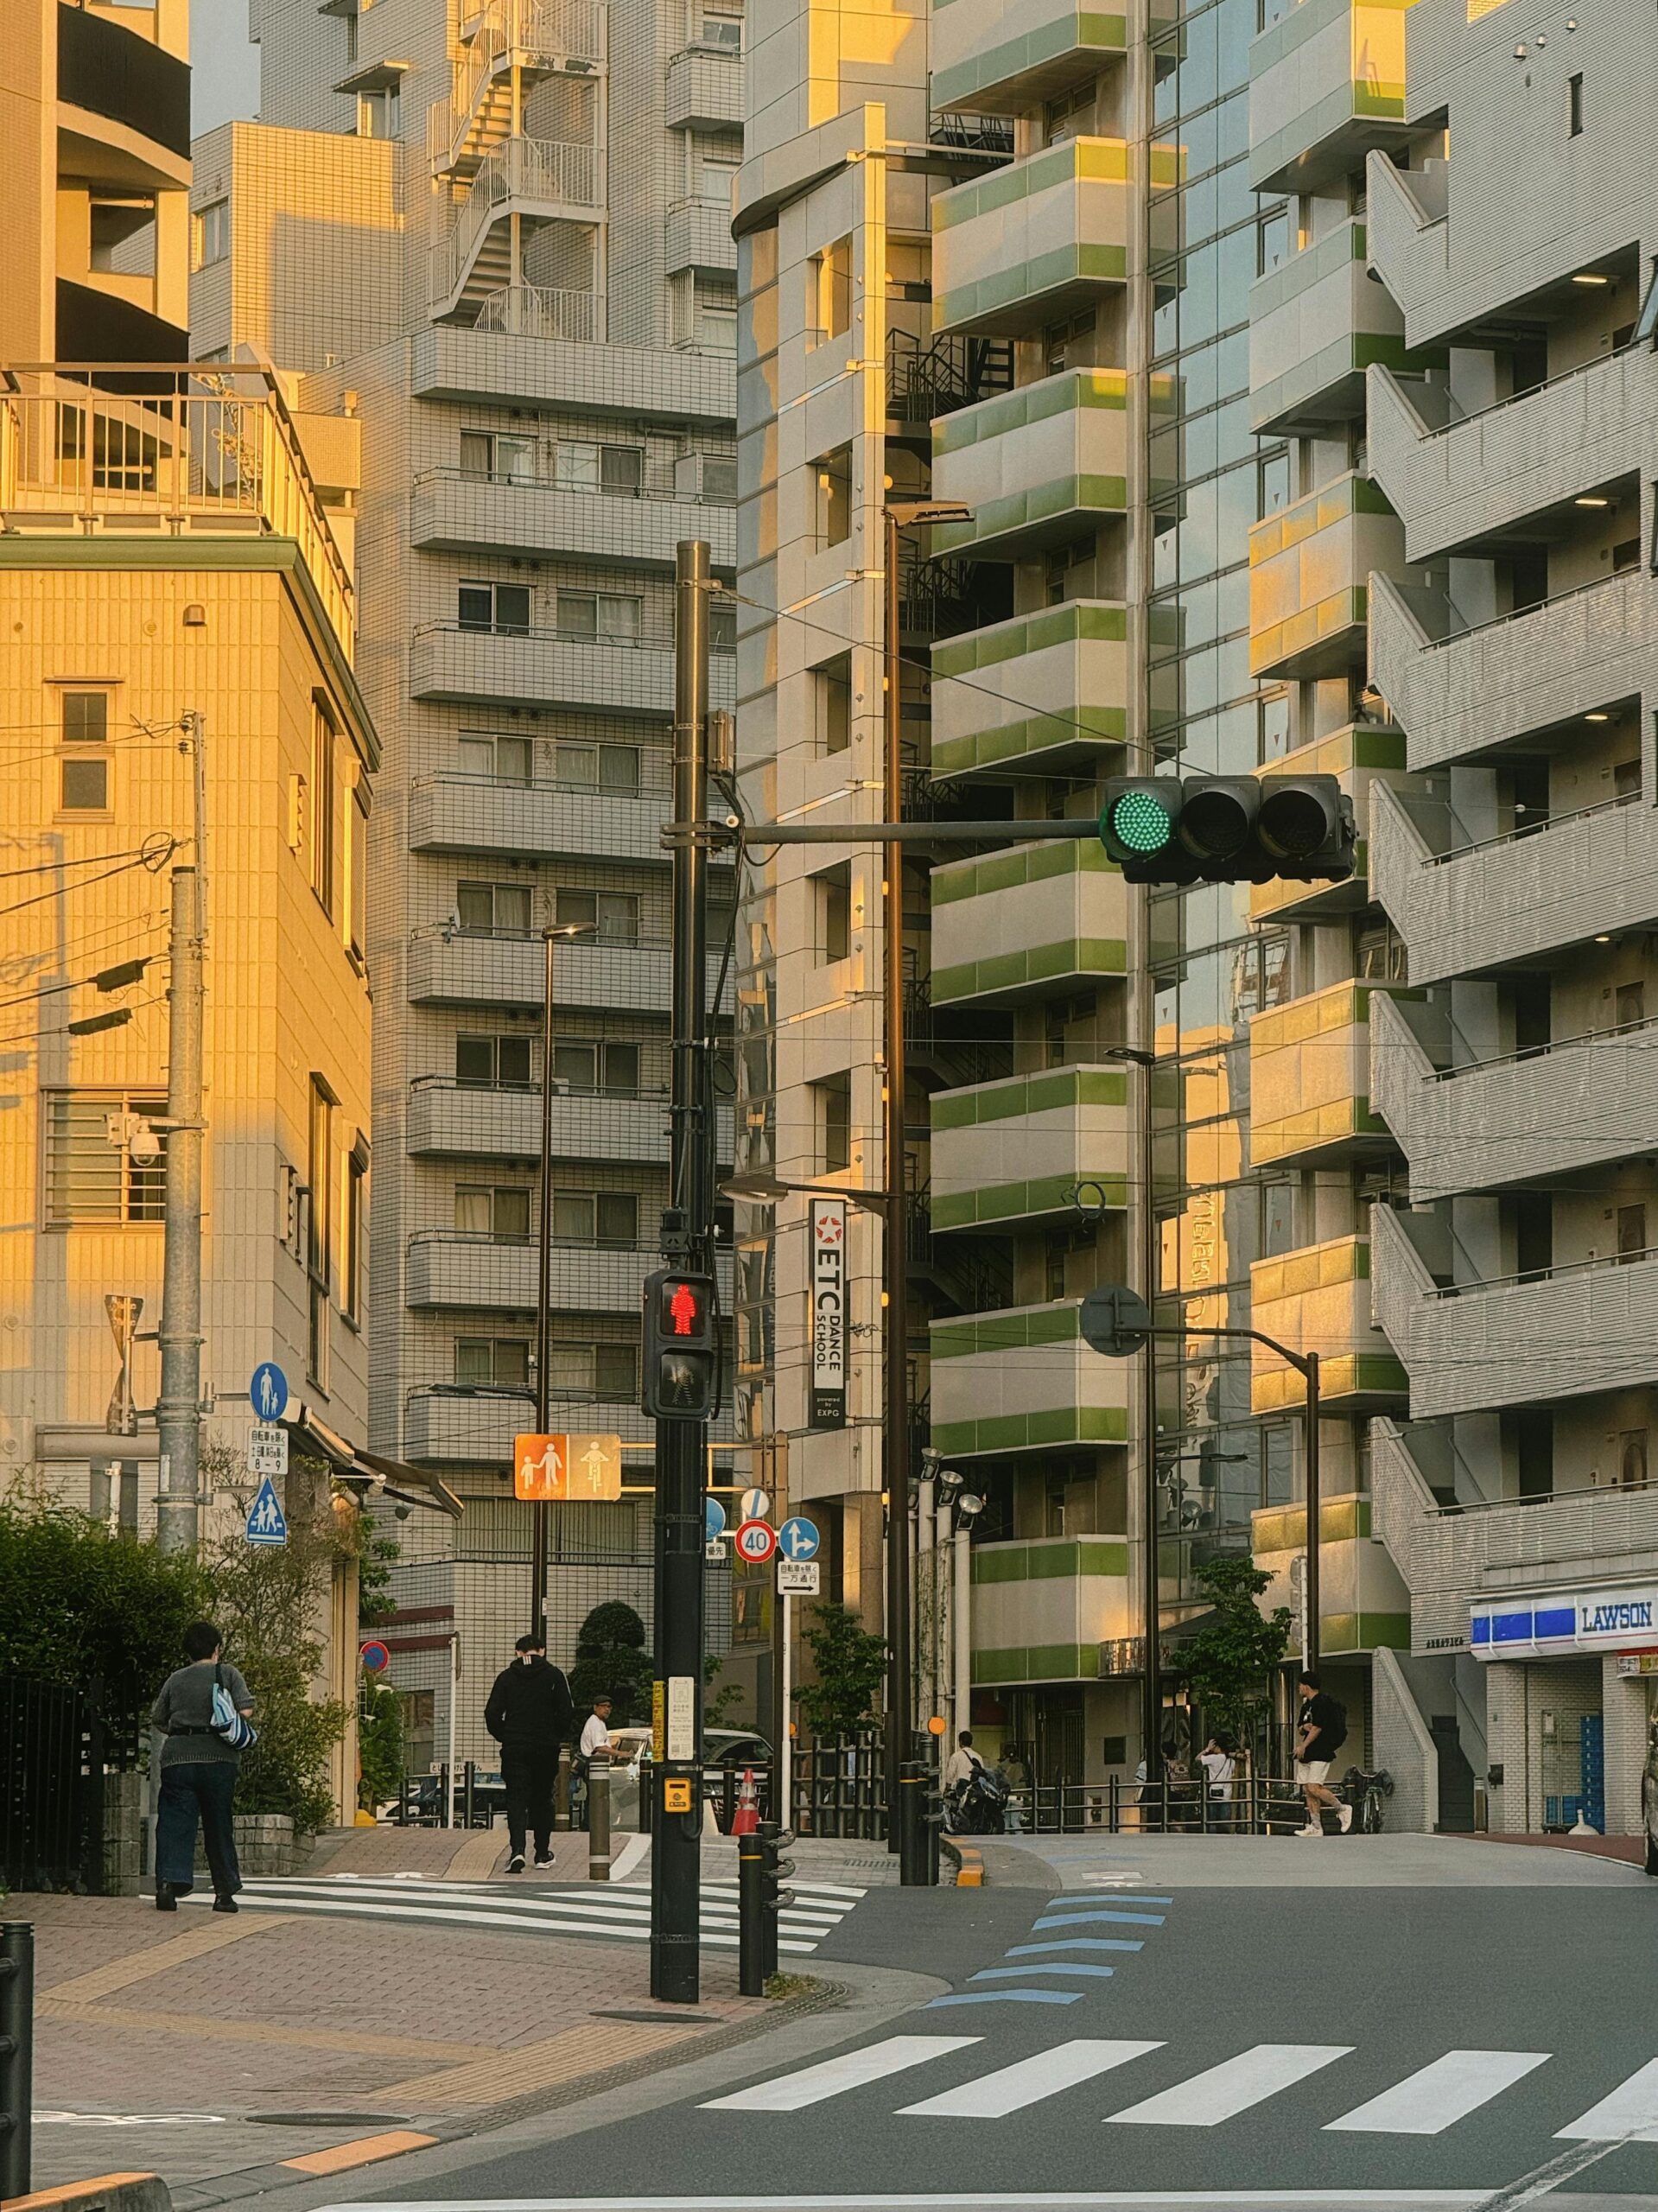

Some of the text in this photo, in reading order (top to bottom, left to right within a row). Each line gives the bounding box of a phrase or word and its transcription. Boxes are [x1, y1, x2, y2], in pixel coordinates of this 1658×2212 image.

[817, 1249, 840, 1311] ETC
[816, 1315, 826, 1370] SCHOOL
[829, 1315, 841, 1371] DANCE
[745, 1532, 767, 1550] 40
[780, 1573, 816, 1583] 一方通行
[1582, 1601, 1653, 1632] LAWSON
